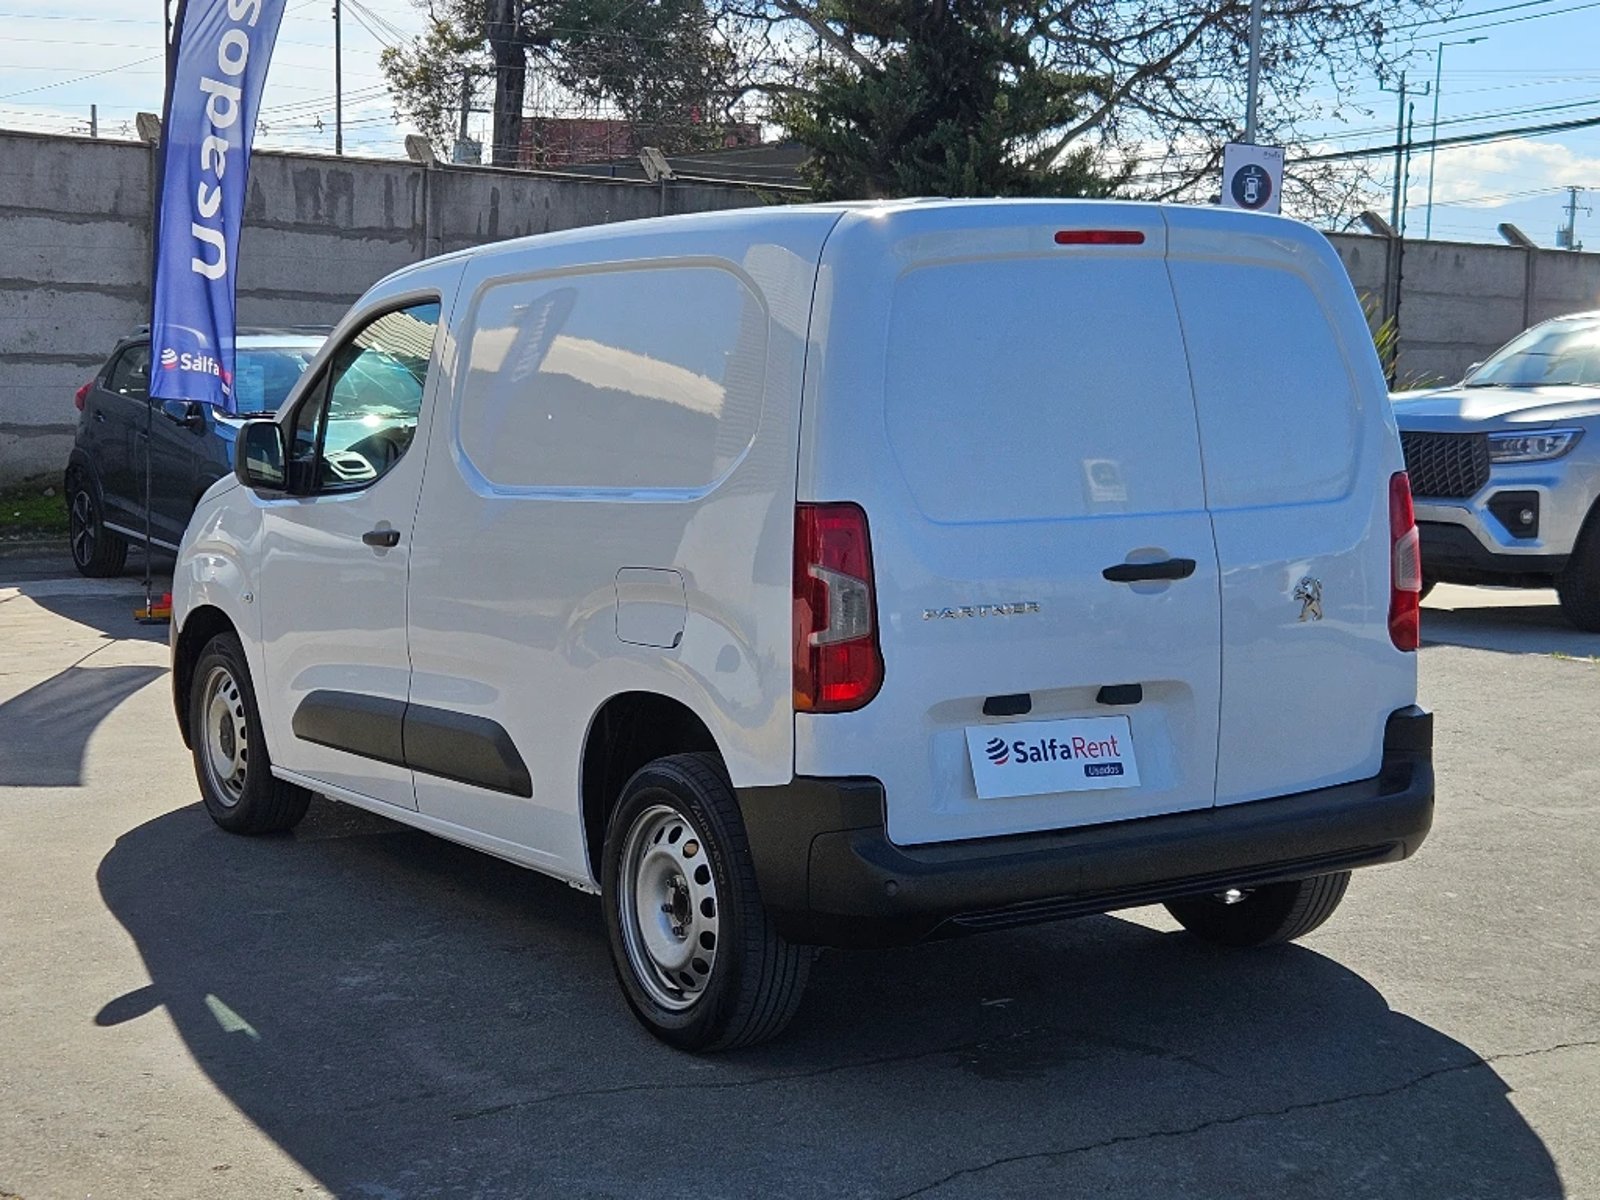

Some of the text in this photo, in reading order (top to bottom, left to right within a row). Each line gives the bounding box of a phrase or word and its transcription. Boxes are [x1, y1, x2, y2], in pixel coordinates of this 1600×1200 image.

[191, 0, 262, 280] Usados
[180, 352, 223, 378] Salfa
[922, 601, 1041, 621] PARTNER
[1012, 735, 1121, 764] SalfaRent
